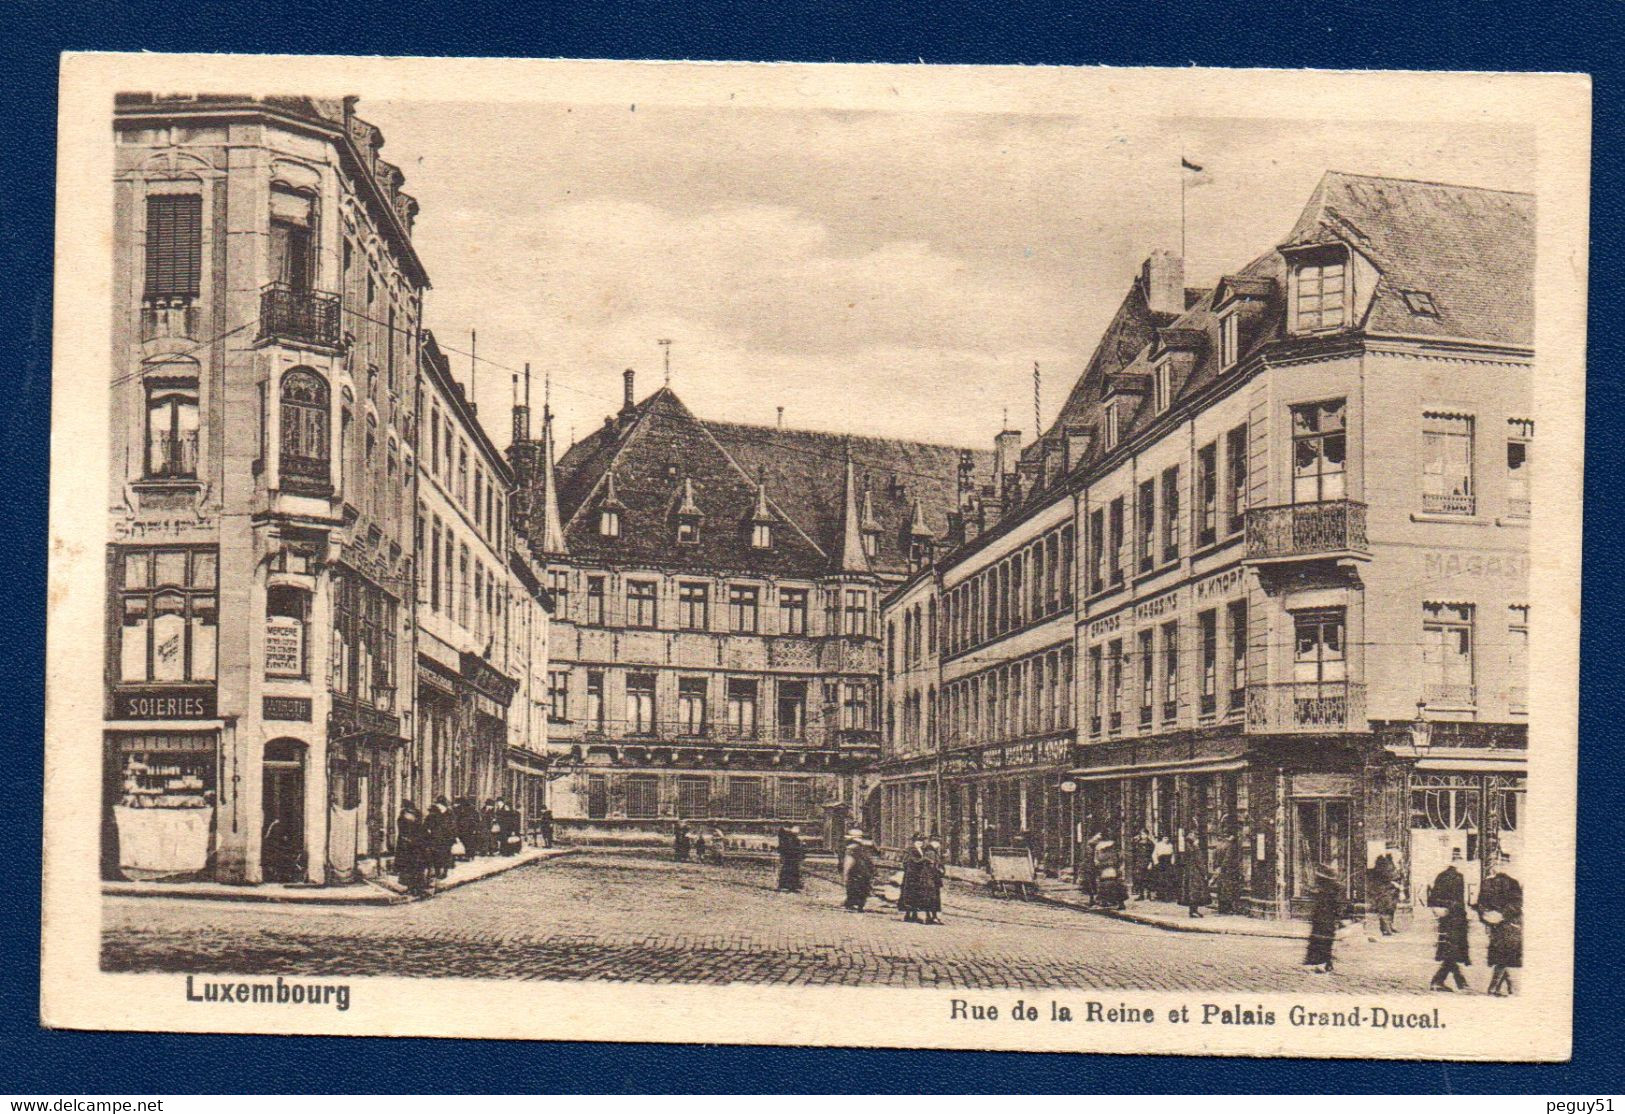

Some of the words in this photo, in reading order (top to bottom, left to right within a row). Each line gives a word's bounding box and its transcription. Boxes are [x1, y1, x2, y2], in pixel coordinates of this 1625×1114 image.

[129, 698, 204, 716] SOIERIES
[186, 975, 350, 1011] Luxembourg
[950, 999, 999, 1021] Rue
[1011, 1000, 1039, 1022] de
[1051, 1001, 1073, 1022] la
[1086, 1001, 1155, 1023] Reine
[1168, 1005, 1189, 1023] et
[1201, 1004, 1275, 1026] Palais
[1289, 1005, 1446, 1029] Grand-Ducal.
